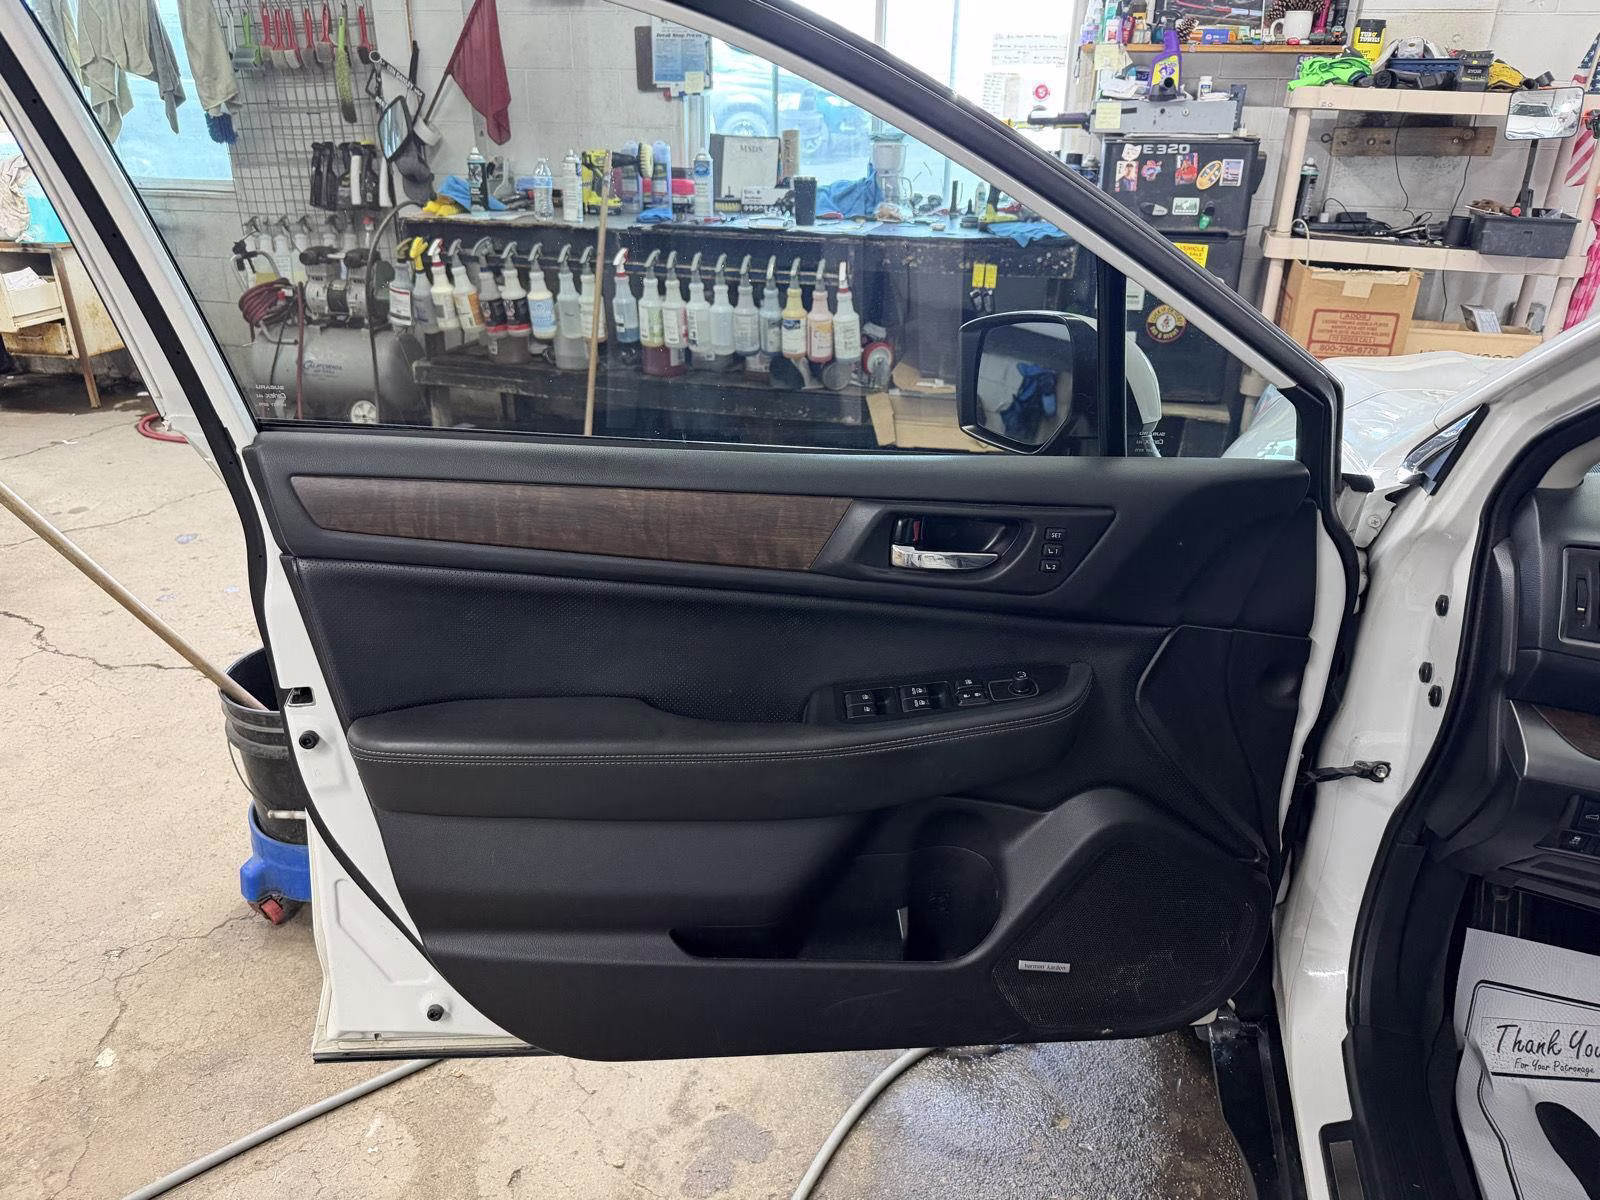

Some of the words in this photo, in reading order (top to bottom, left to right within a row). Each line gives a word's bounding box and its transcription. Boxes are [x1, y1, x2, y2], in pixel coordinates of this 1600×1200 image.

[739, 144, 763, 153] MSDS
[1142, 144, 1154, 154] E
[1155, 144, 1191, 155] 320
[1496, 1024, 1562, 1057] Thank
[1514, 1058, 1530, 1069] For
[1531, 1059, 1551, 1071] Your
[1553, 1060, 1596, 1077] Patronage
